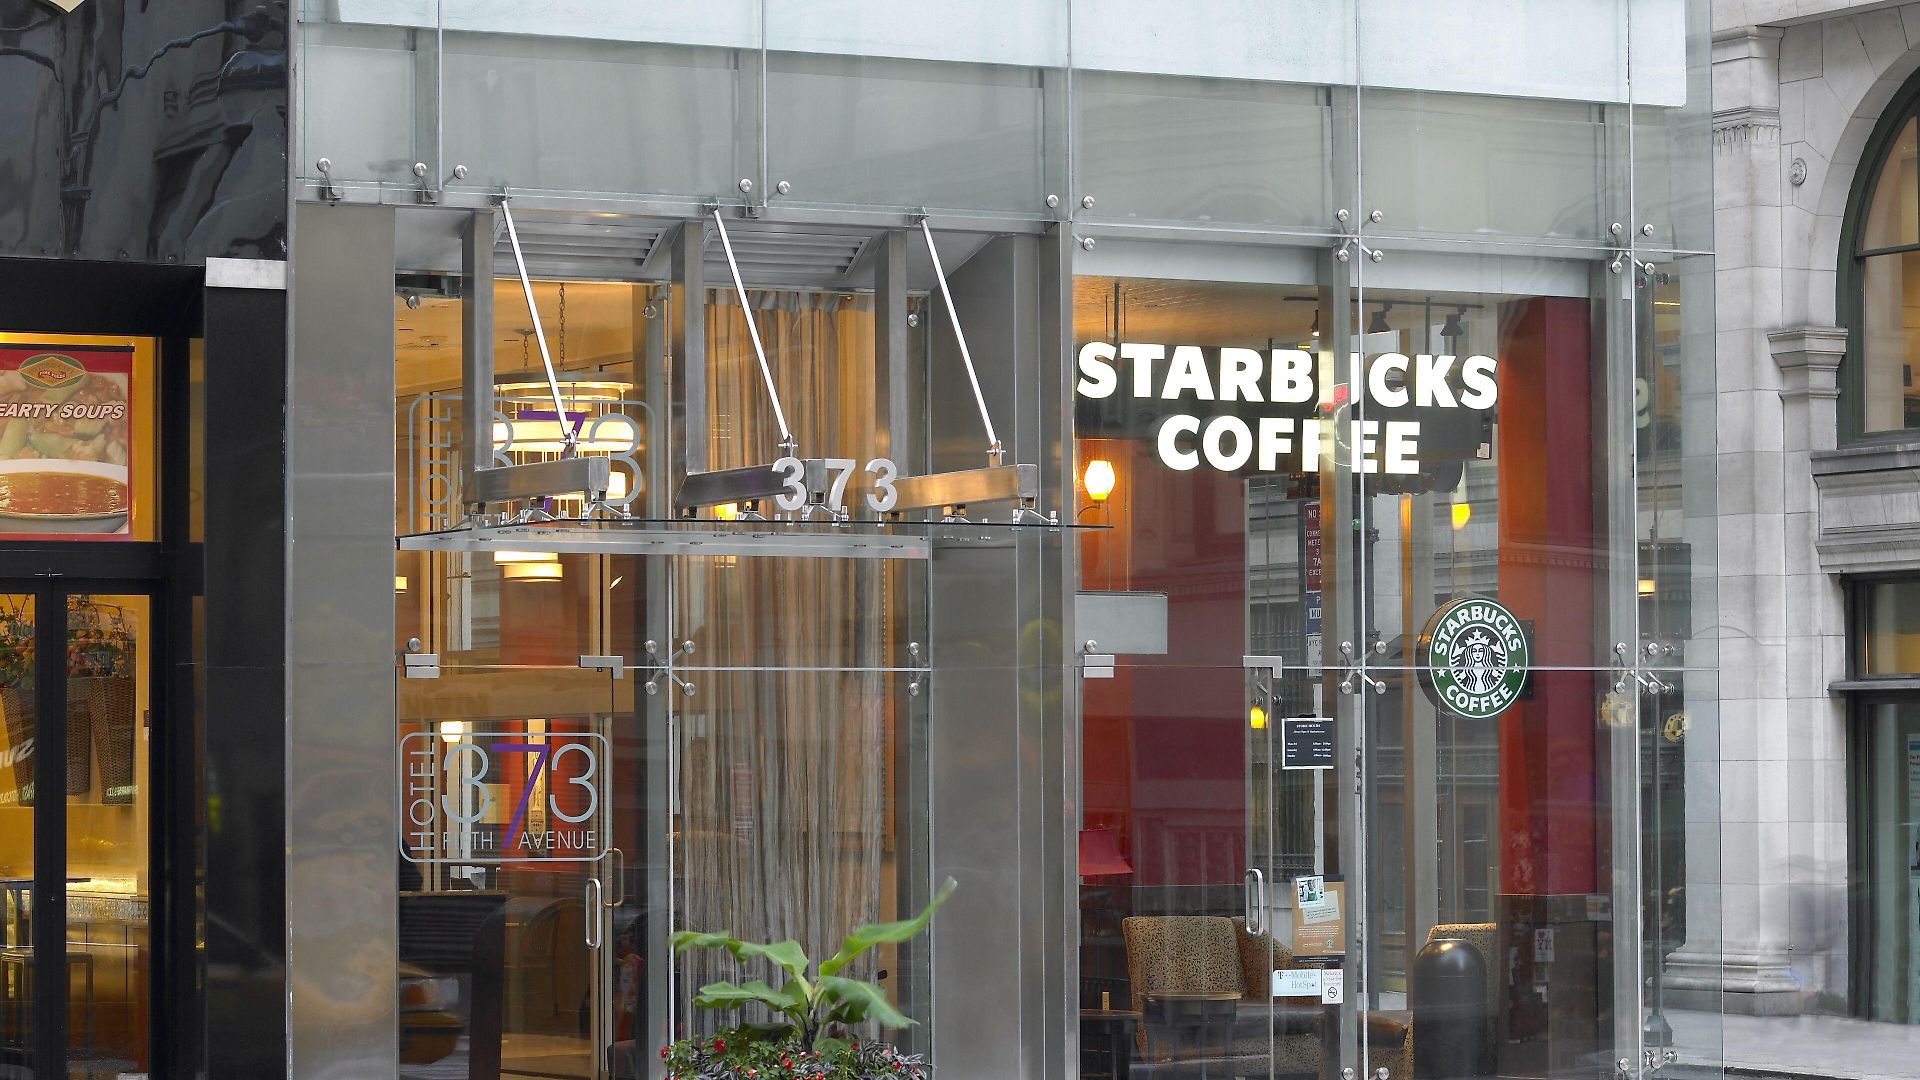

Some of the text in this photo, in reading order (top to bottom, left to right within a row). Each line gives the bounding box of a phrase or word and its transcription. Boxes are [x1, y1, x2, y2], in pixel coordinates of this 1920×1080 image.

[1077, 341, 1498, 410] STARBUCKS
[60, 404, 125, 419] SOUPS
[1157, 414, 1421, 475] COFFEE
[772, 456, 898, 512] 373
[1308, 509, 1317, 518] NO
[1434, 605, 1521, 656] STARBUCKS
[1446, 682, 1513, 712] COFFEE
[409, 742, 435, 851] HOTEL
[441, 743, 598, 849] 373
[518, 831, 596, 849] AVENUE
